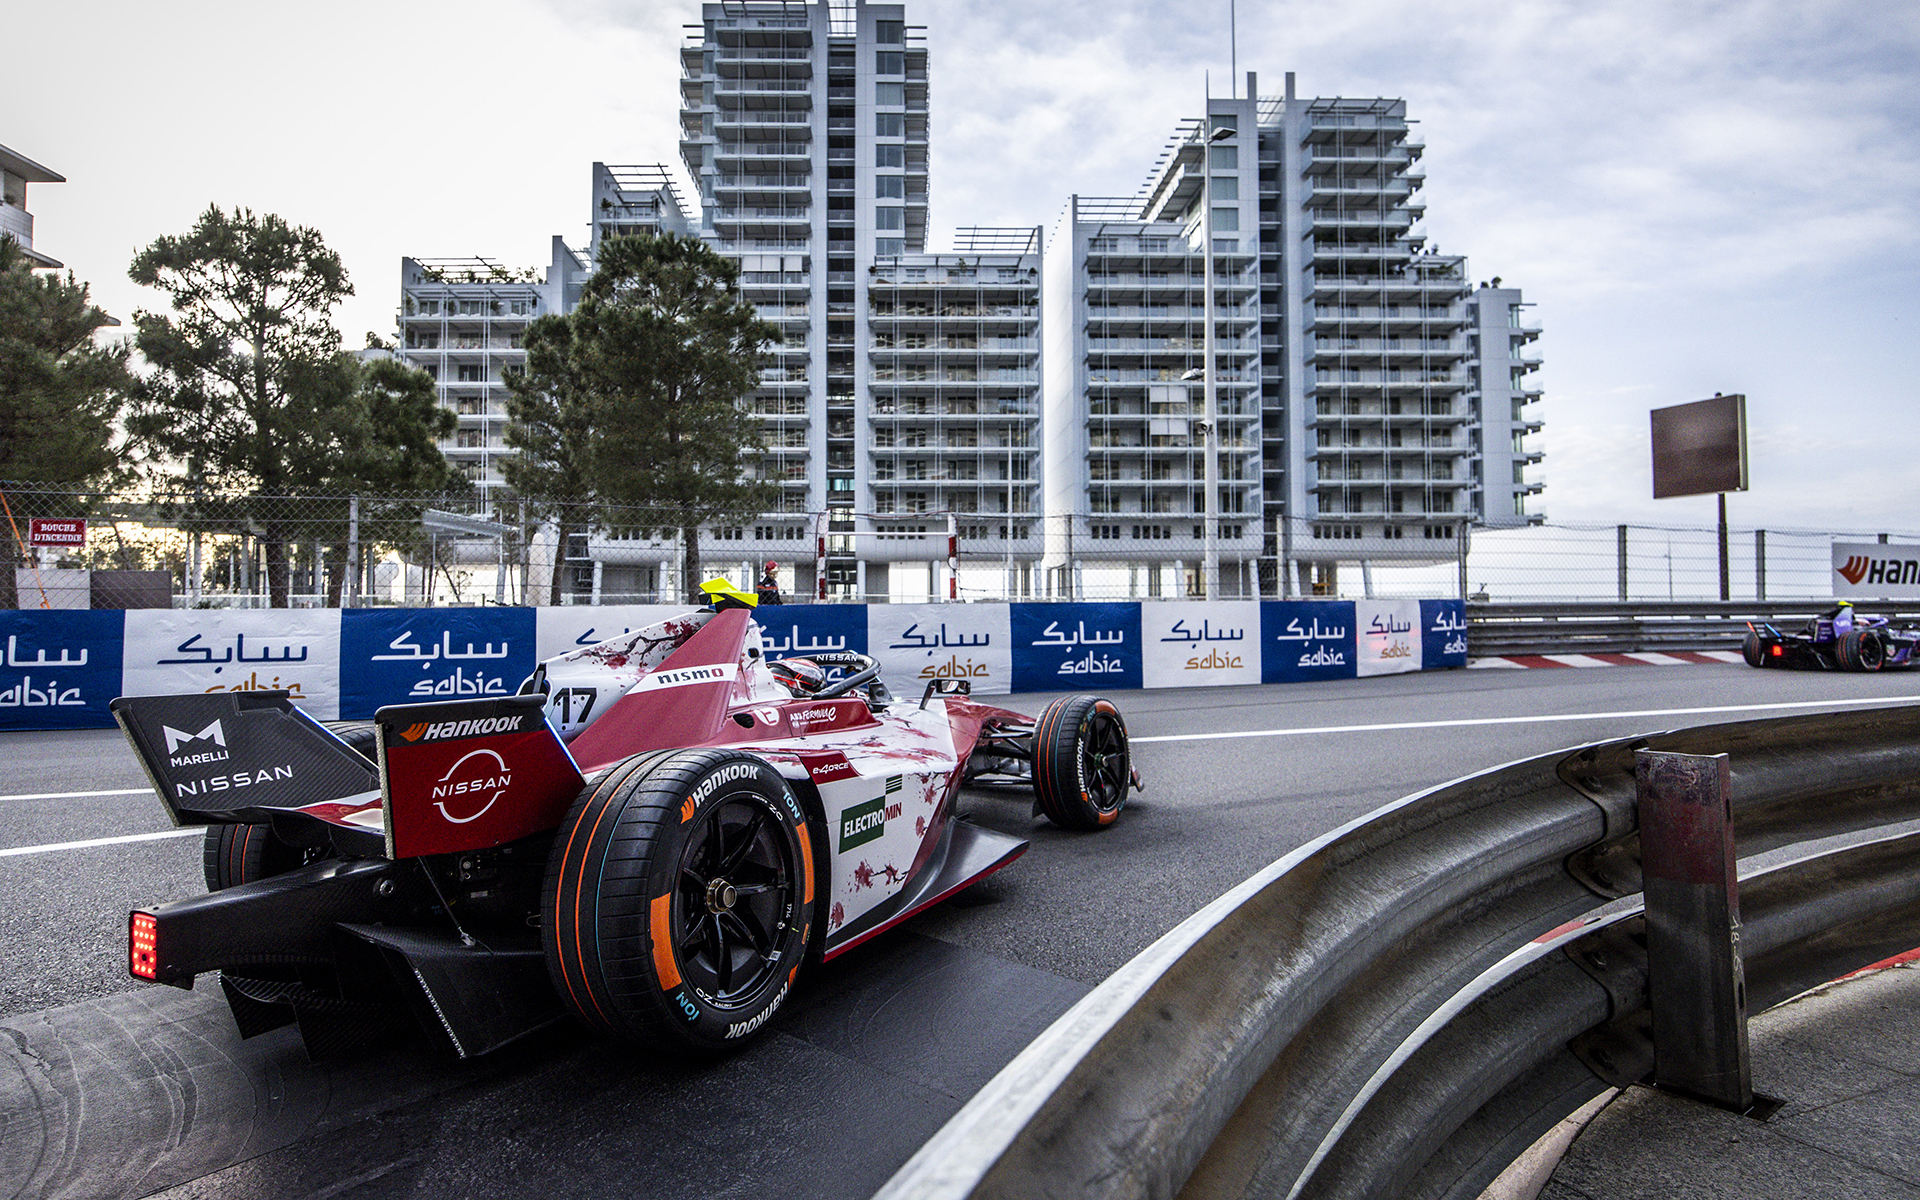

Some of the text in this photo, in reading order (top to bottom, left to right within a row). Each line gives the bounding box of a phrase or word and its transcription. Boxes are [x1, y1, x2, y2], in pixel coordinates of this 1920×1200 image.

[41, 523, 76, 532] BOUCHE
[1868, 559, 1920, 584] Han
[816, 654, 858, 662] NISSAN
[1184, 647, 1244, 670] sabic
[1298, 645, 1346, 667] sabic
[1380, 639, 1411, 659] sabic
[917, 655, 990, 680] sabic
[1057, 650, 1124, 675] sabic
[408, 667, 508, 696] sabic
[552, 687, 597, 724] 17
[171, 750, 229, 768] MARELLI
[176, 764, 293, 798] NISSAN
[431, 774, 512, 799] NISSAN
[844, 802, 902, 838] ELECTROMIN
